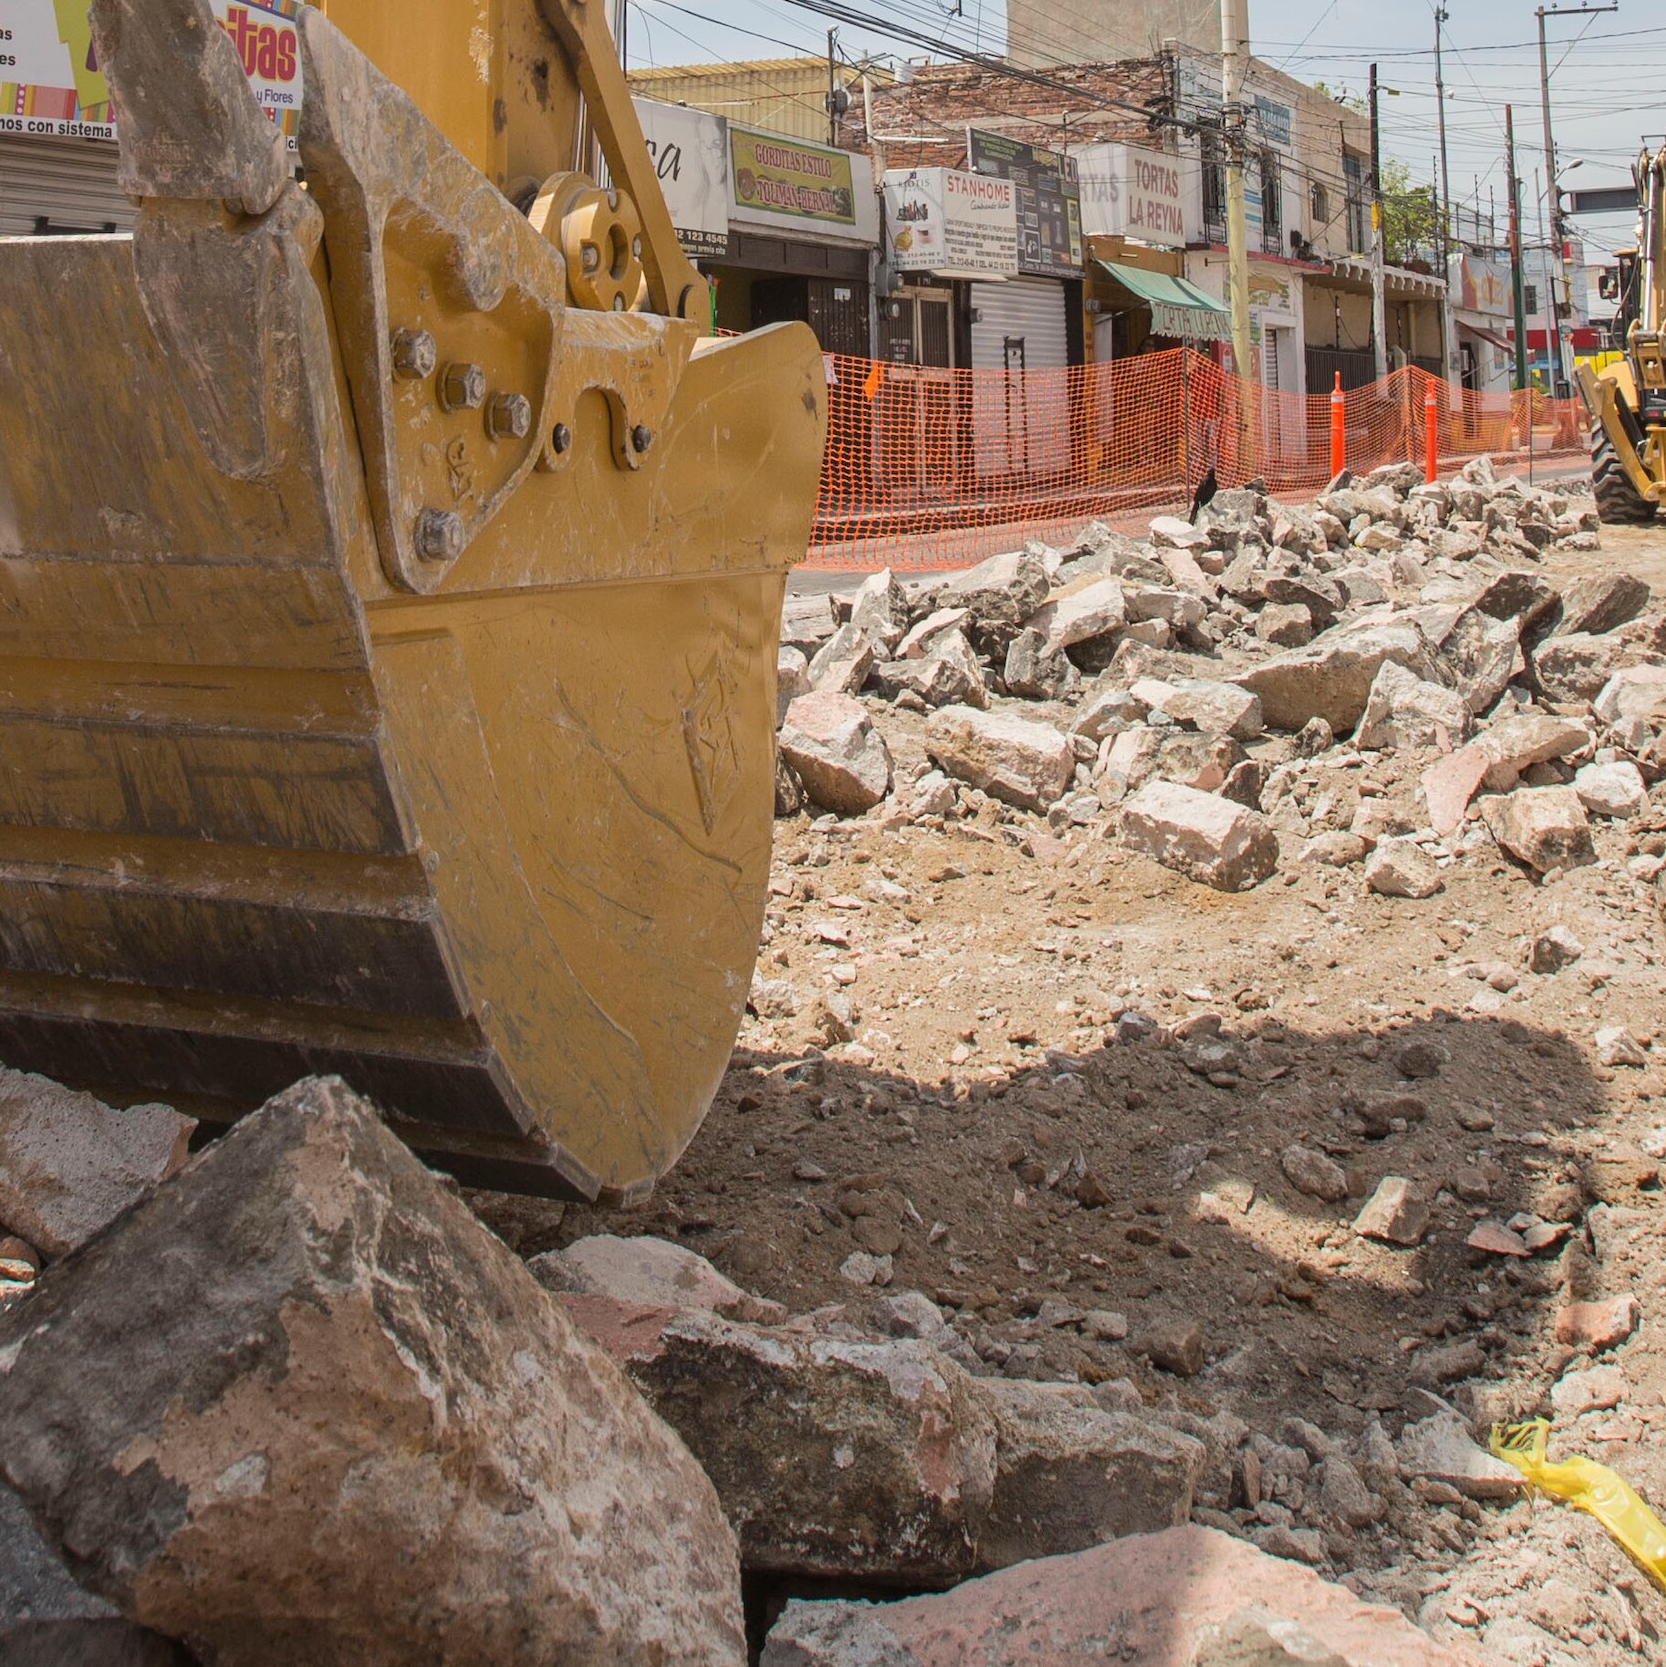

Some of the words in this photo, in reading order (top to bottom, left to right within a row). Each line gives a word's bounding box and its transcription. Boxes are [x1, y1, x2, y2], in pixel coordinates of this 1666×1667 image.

[217, 6, 297, 81] itas
[256, 90, 263, 105] y
[265, 89, 294, 104] Flores
[28, 118, 54, 134] con
[58, 120, 112, 138] sistema
[755, 143, 800, 172] GORDITAS
[802, 154, 832, 179] ESTILO
[947, 175, 1010, 202] STANHOME
[1134, 159, 1178, 198] TORTAS
[1129, 195, 1144, 226] LA
[1147, 200, 1184, 236] REYNA
[686, 230, 704, 242] 123
[705, 232, 728, 245] 4545
